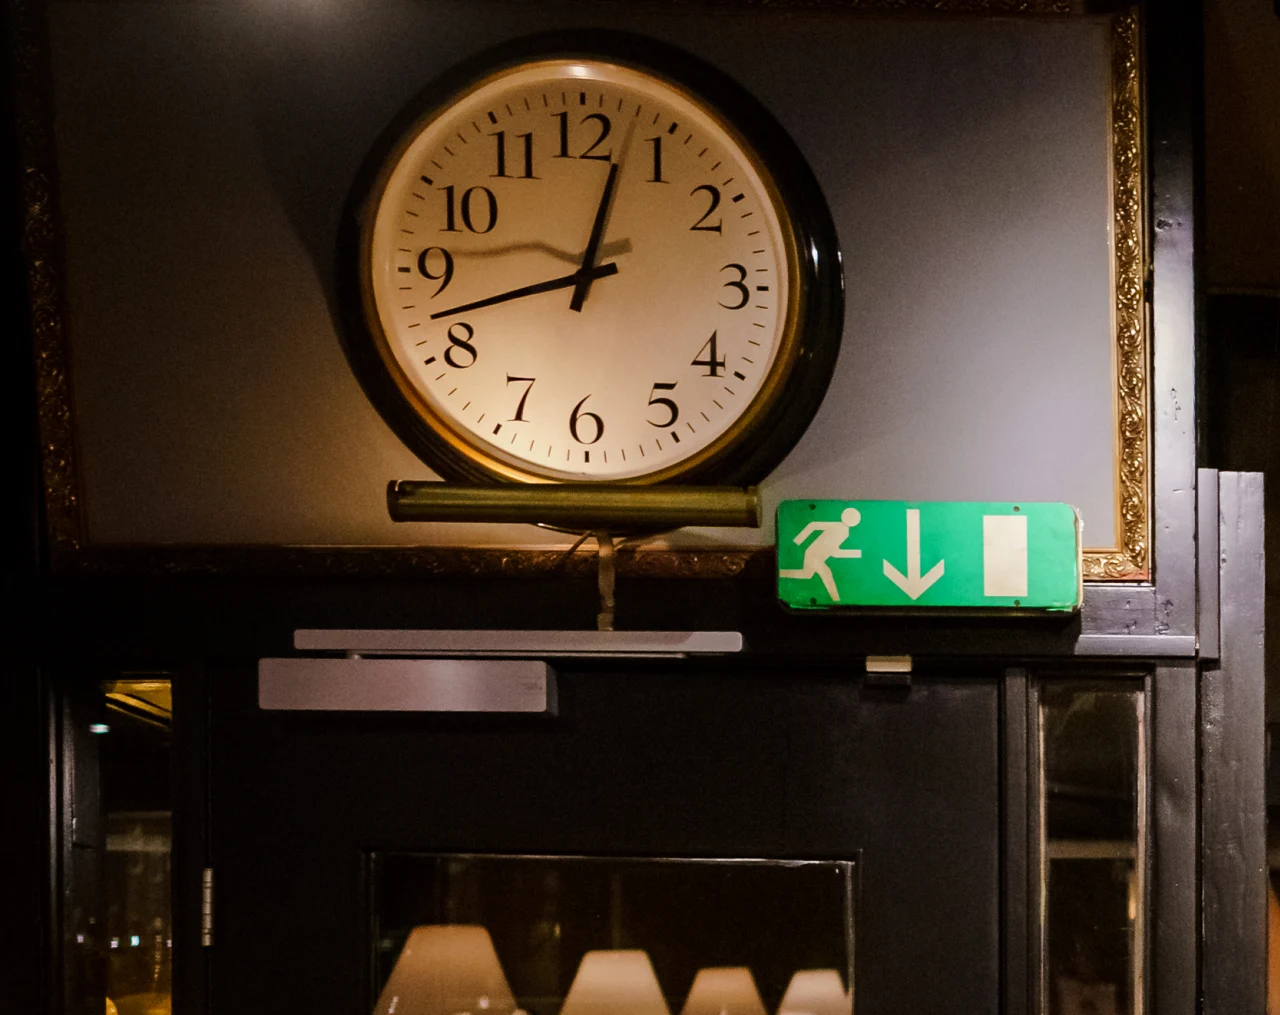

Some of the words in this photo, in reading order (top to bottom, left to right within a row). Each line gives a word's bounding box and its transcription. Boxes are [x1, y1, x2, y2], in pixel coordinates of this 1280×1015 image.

[486, 131, 542, 180] 11
[551, 111, 613, 162] 12
[644, 136, 670, 183] 1
[438, 184, 498, 234] 10
[689, 184, 723, 235] 2
[417, 247, 454, 299] 9
[718, 263, 750, 310] 3
[443, 322, 478, 369] 8
[691, 330, 726, 378] 4
[505, 373, 536, 423] 7
[568, 394, 605, 445] 6
[646, 382, 679, 428] 5
